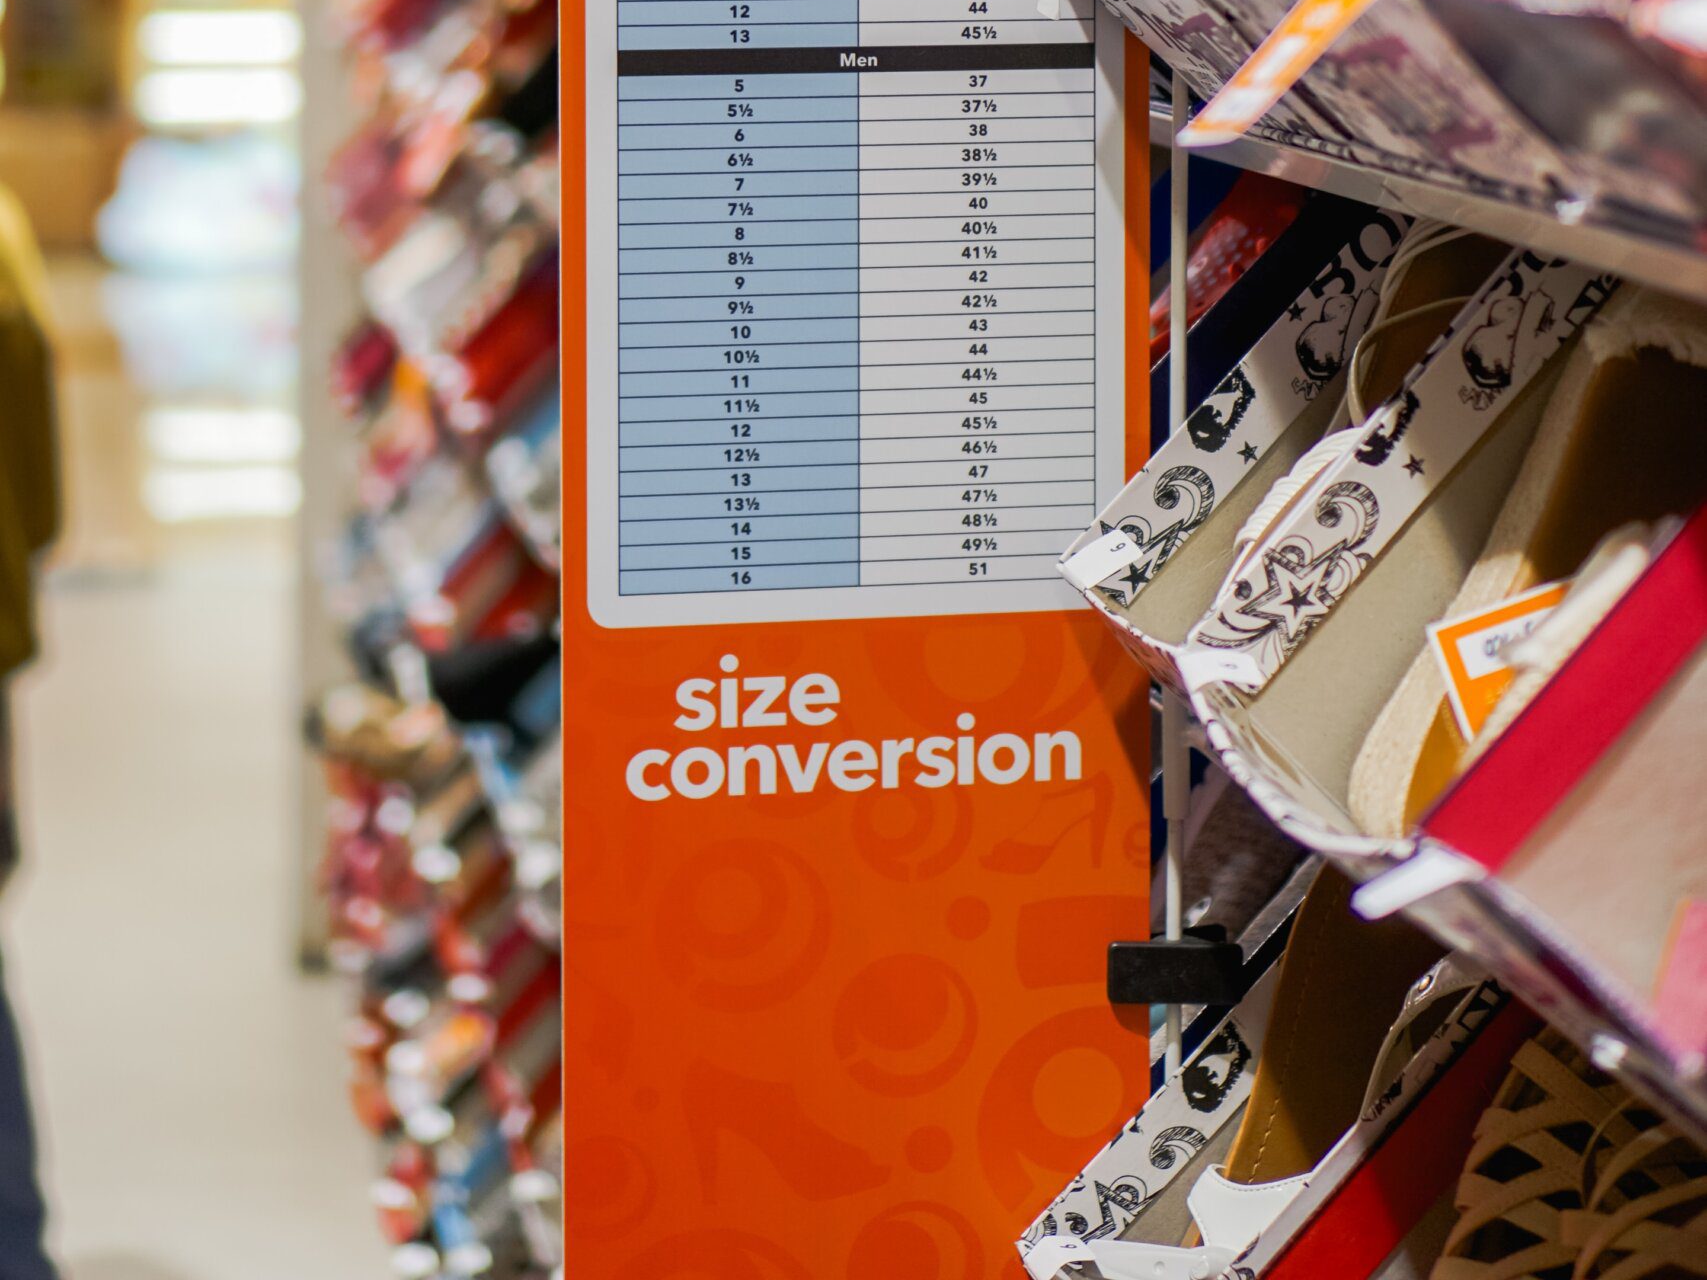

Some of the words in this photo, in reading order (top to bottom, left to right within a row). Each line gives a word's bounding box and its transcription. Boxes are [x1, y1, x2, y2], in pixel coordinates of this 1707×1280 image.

[729, 4, 750, 19] 12
[968, 1, 988, 14] 44
[729, 29, 750, 43] 13
[840, 52, 878, 67] Men
[734, 78, 744, 93] 5
[968, 74, 988, 88] 37
[734, 128, 745, 142] 6
[968, 123, 988, 137] 38
[734, 177, 745, 191] 7
[968, 196, 988, 210] 40
[734, 226, 745, 241] 8
[734, 276, 745, 290] 9
[968, 270, 988, 283] 42
[730, 325, 751, 339] 10
[968, 318, 988, 332] 43
[968, 343, 988, 356] 44
[730, 374, 749, 389] 11
[968, 391, 988, 405] 45
[730, 423, 751, 438] 12
[968, 464, 989, 478] 47
[730, 472, 751, 487] 13
[730, 522, 752, 536] 14
[731, 546, 752, 560] 15
[968, 562, 987, 576] 51
[730, 571, 752, 585] 16
[673, 653, 840, 731] size
[625, 711, 1081, 801] conversion
